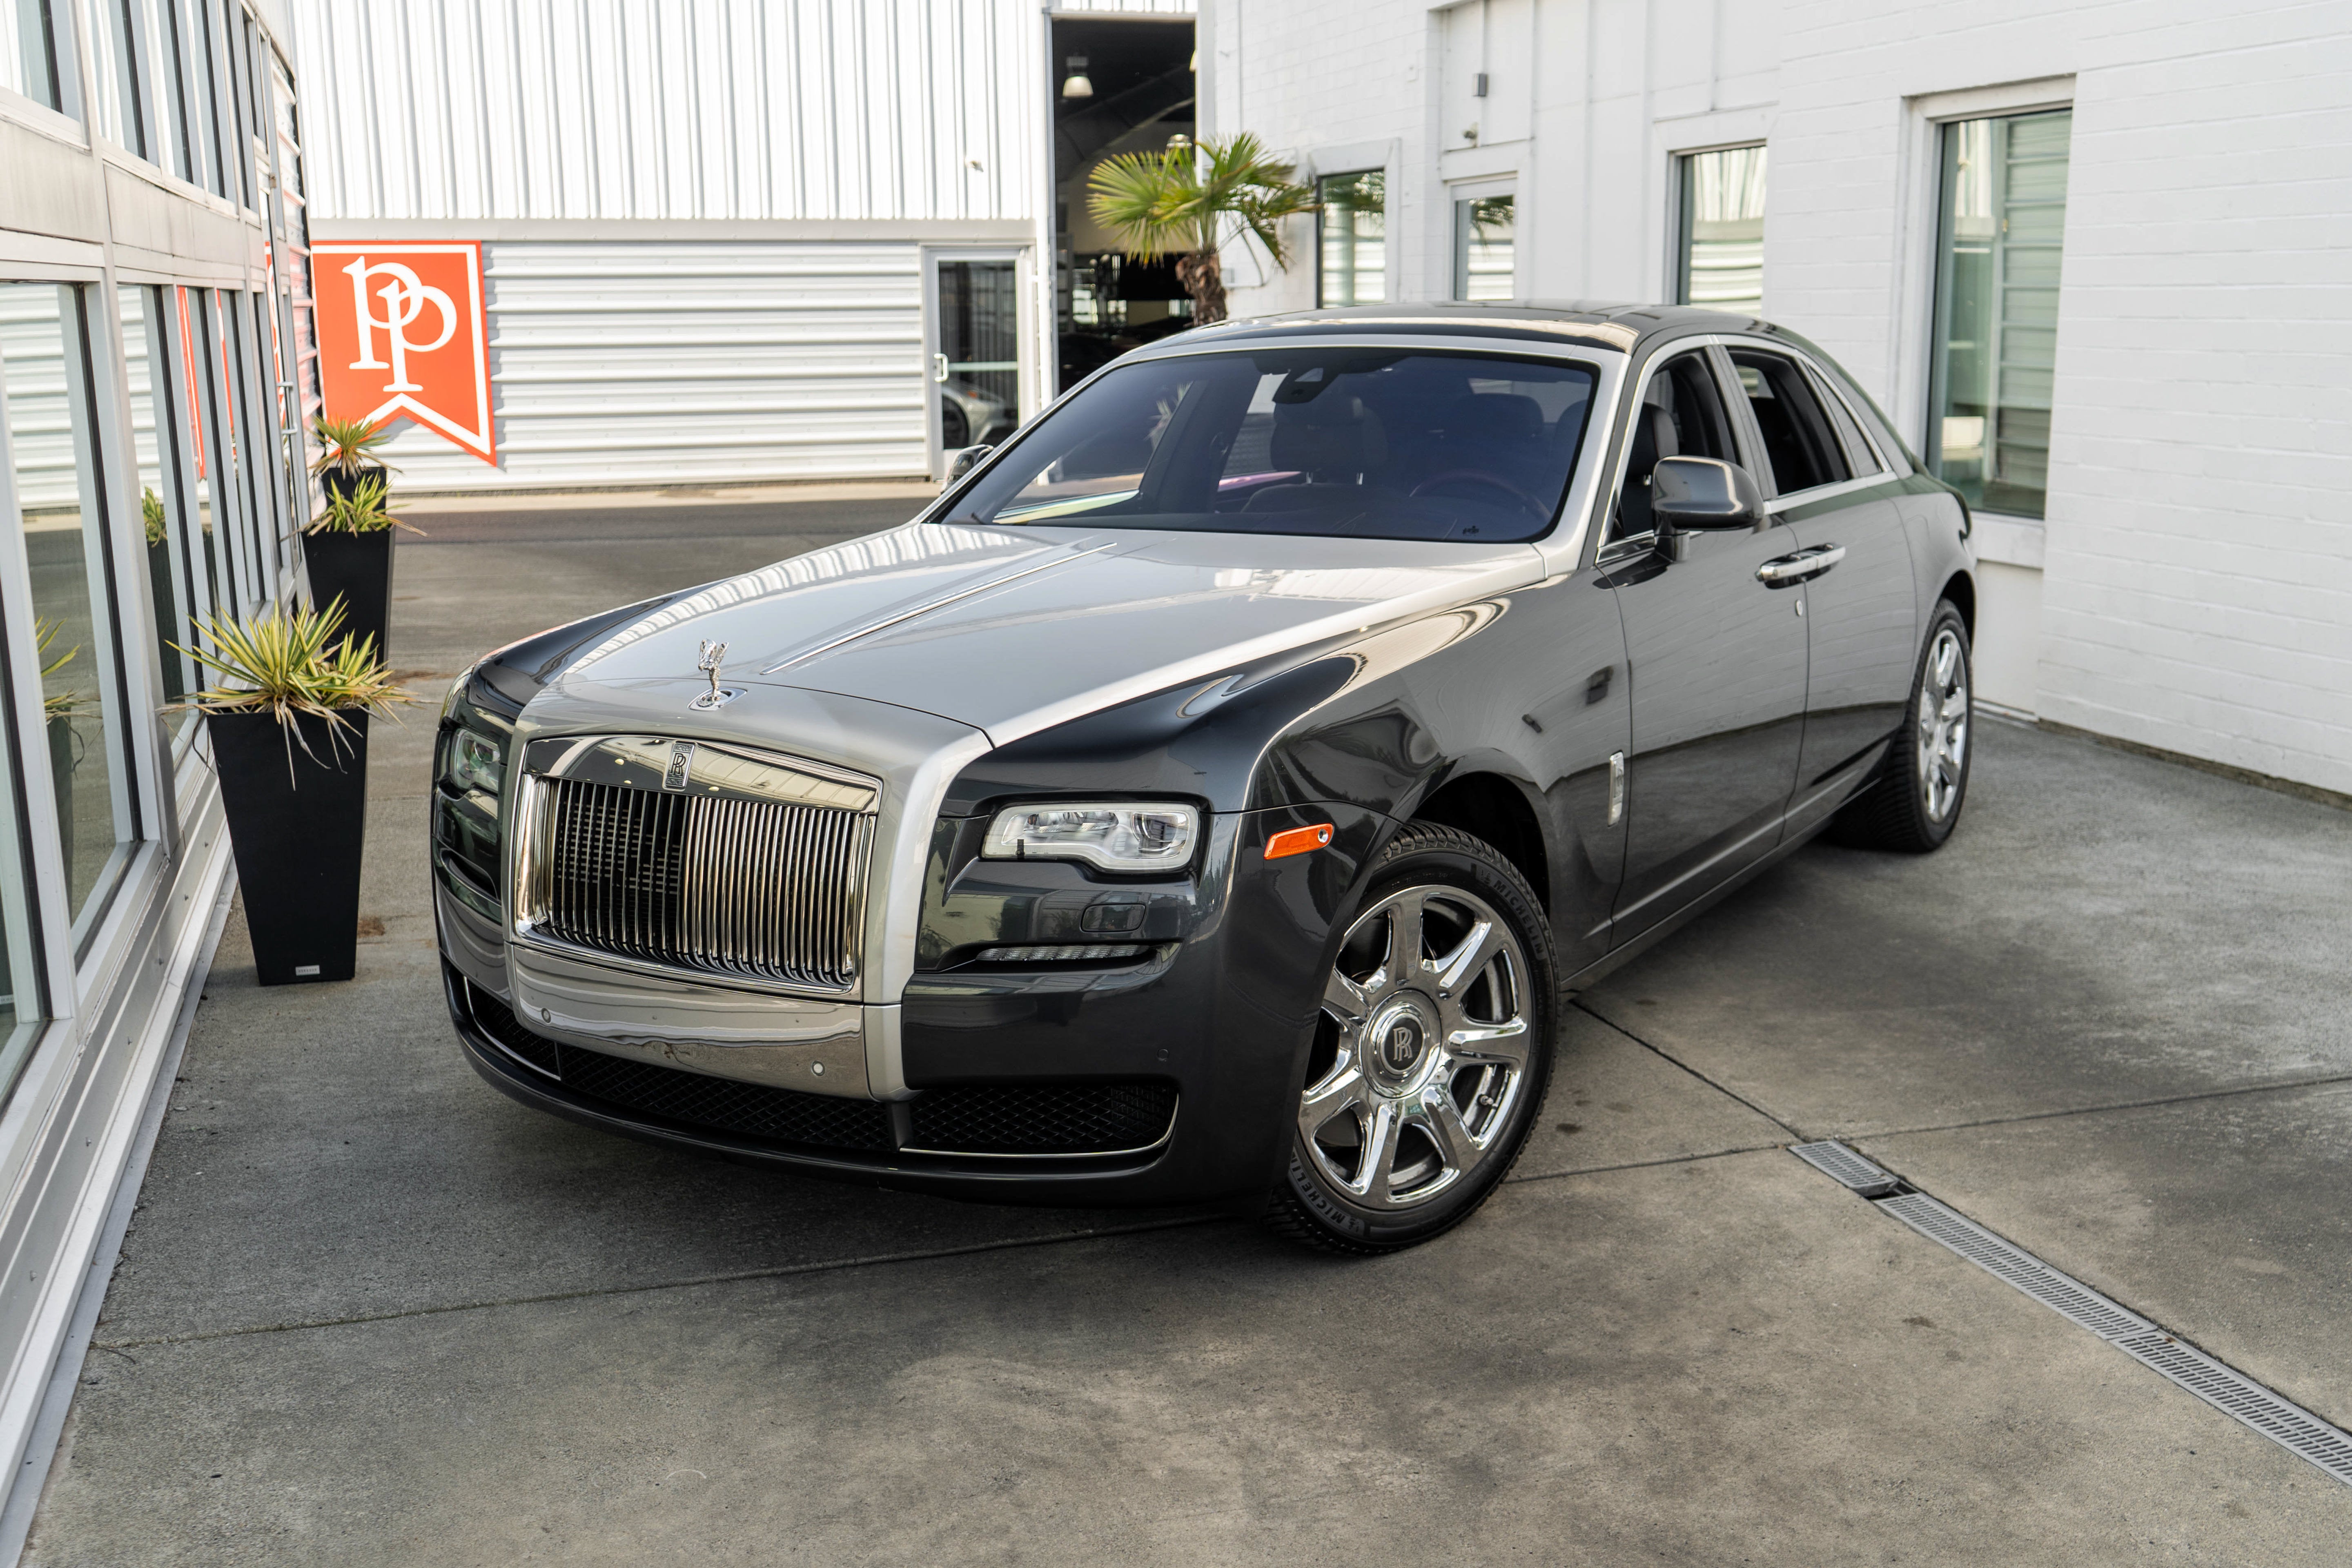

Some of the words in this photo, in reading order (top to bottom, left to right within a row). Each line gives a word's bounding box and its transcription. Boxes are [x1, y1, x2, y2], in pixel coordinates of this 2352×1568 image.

[670, 753, 686, 777] RR
[1493, 880, 1544, 954] MICHELIN
[1393, 1027, 1413, 1061] RR
